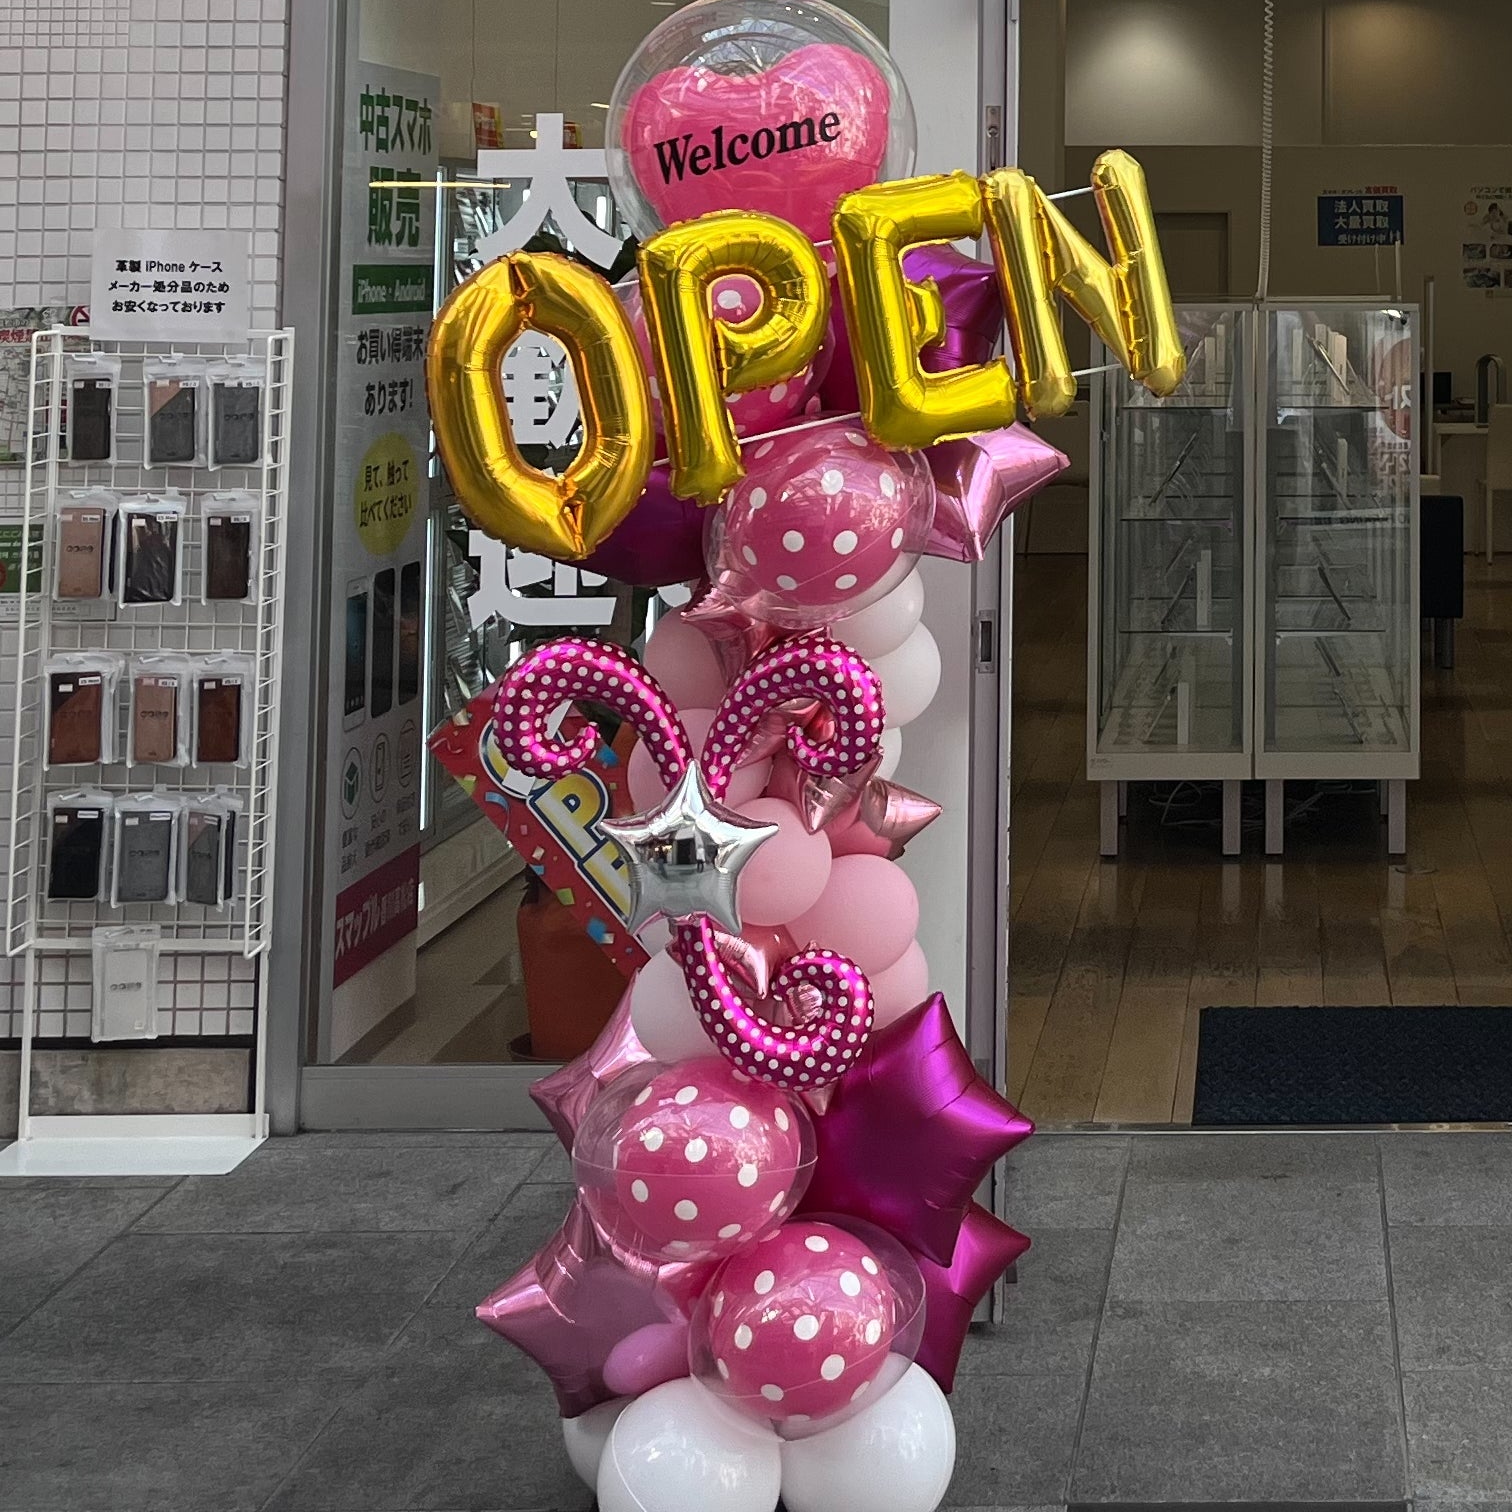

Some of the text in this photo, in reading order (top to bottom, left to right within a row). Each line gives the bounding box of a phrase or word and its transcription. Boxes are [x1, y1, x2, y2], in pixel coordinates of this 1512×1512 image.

[358, 83, 433, 157] 中古スマホ
[653, 109, 843, 186] Welcome
[366, 165, 422, 248] 販売
[1333, 199, 1389, 214] 法人買取
[108, 280, 230, 294] メーカー処分品のため
[115, 259, 223, 273] 革製 iPhone ケース
[111, 299, 226, 314] お安くなっております
[424, 149, 1187, 561] OPEN
